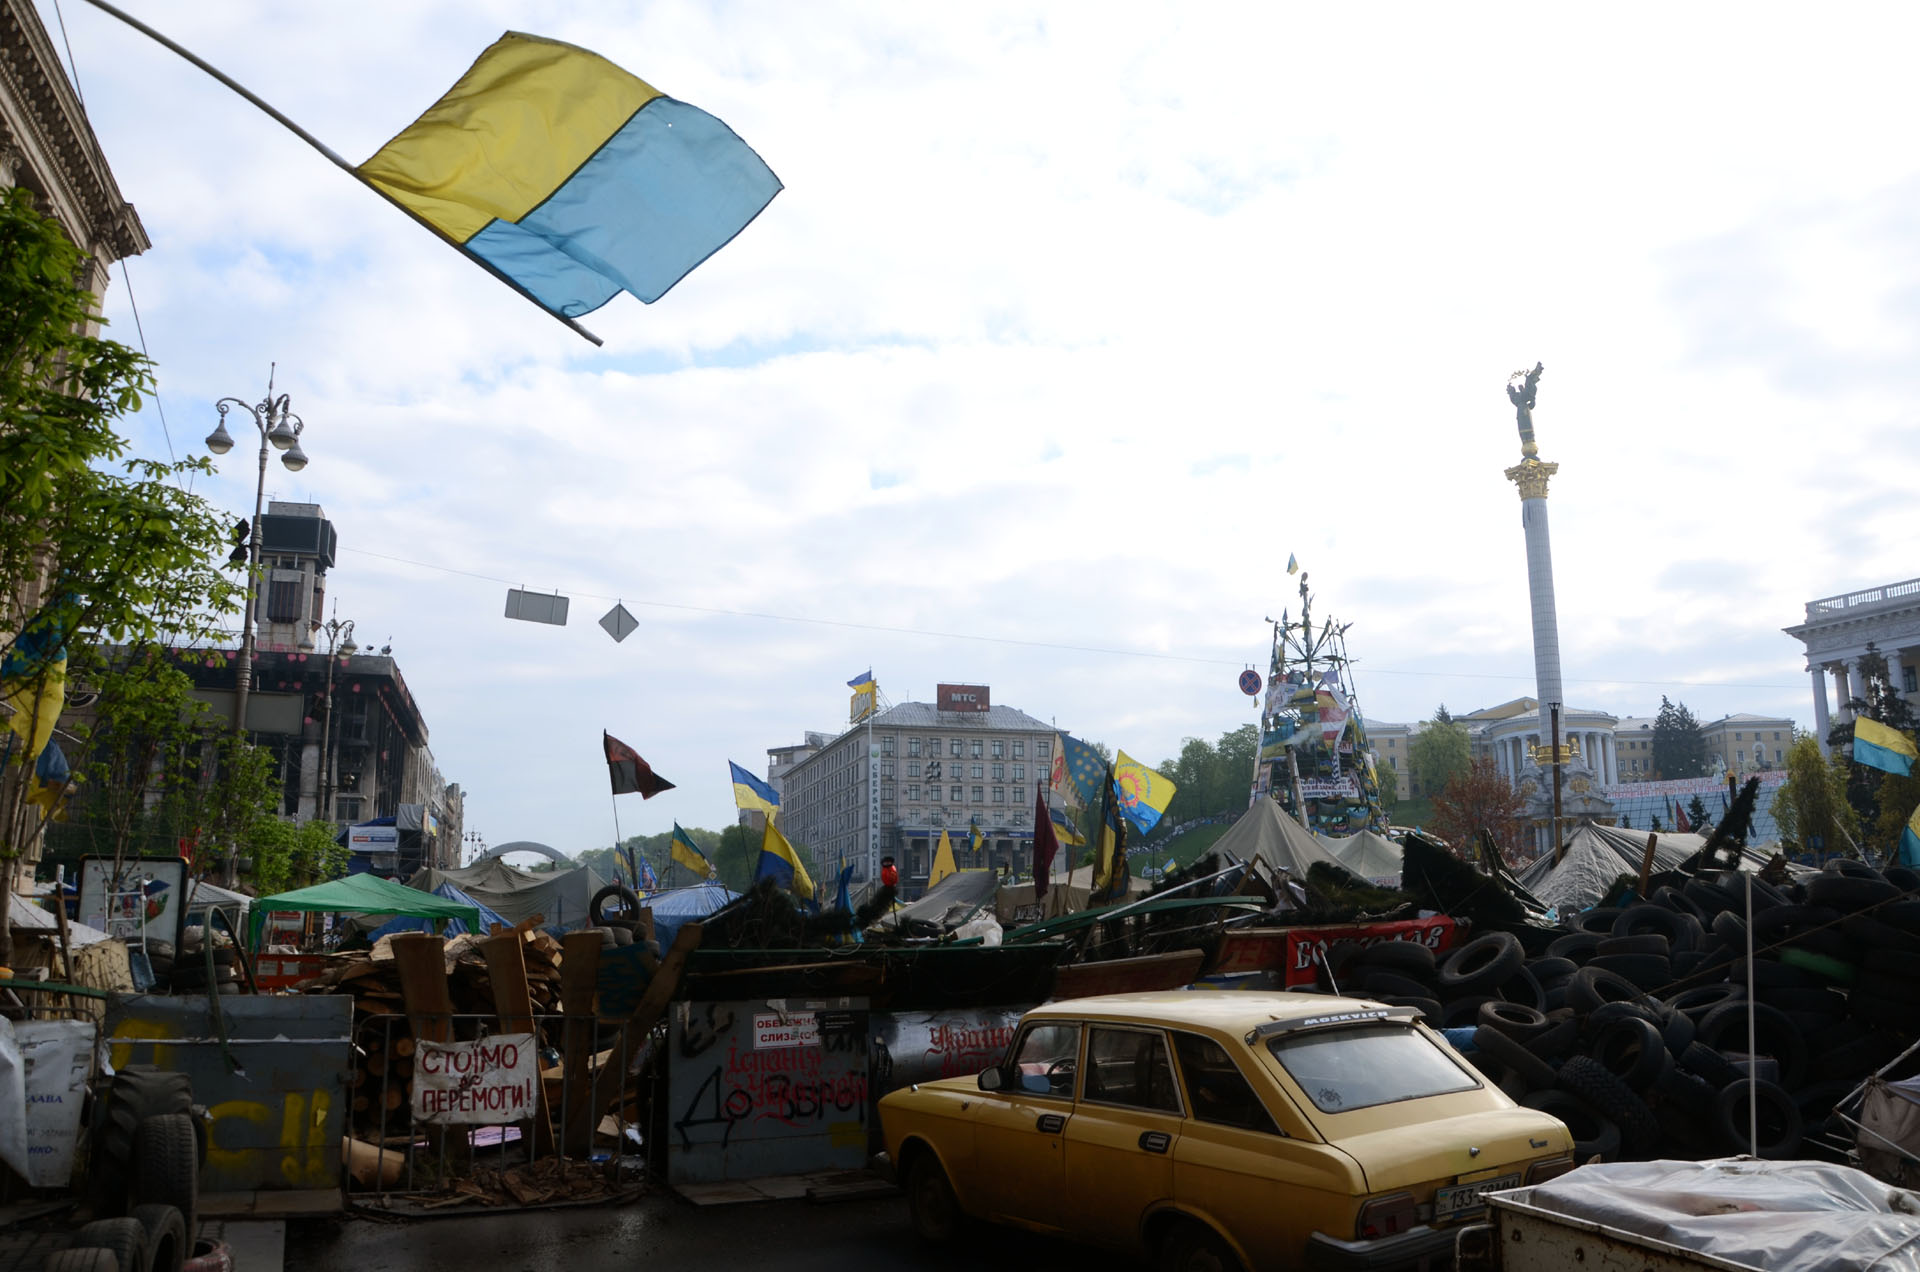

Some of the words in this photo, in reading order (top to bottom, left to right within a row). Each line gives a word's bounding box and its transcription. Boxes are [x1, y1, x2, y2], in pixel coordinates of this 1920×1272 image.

[951, 692, 977, 703] МТС
[871, 763, 879, 829] СБЕРБАНК
[1303, 1010, 1389, 1026] MOSKVICH
[423, 1042, 518, 1074] СТОЇМО
[423, 1078, 531, 1113] ПЕРЕМОГИ!
